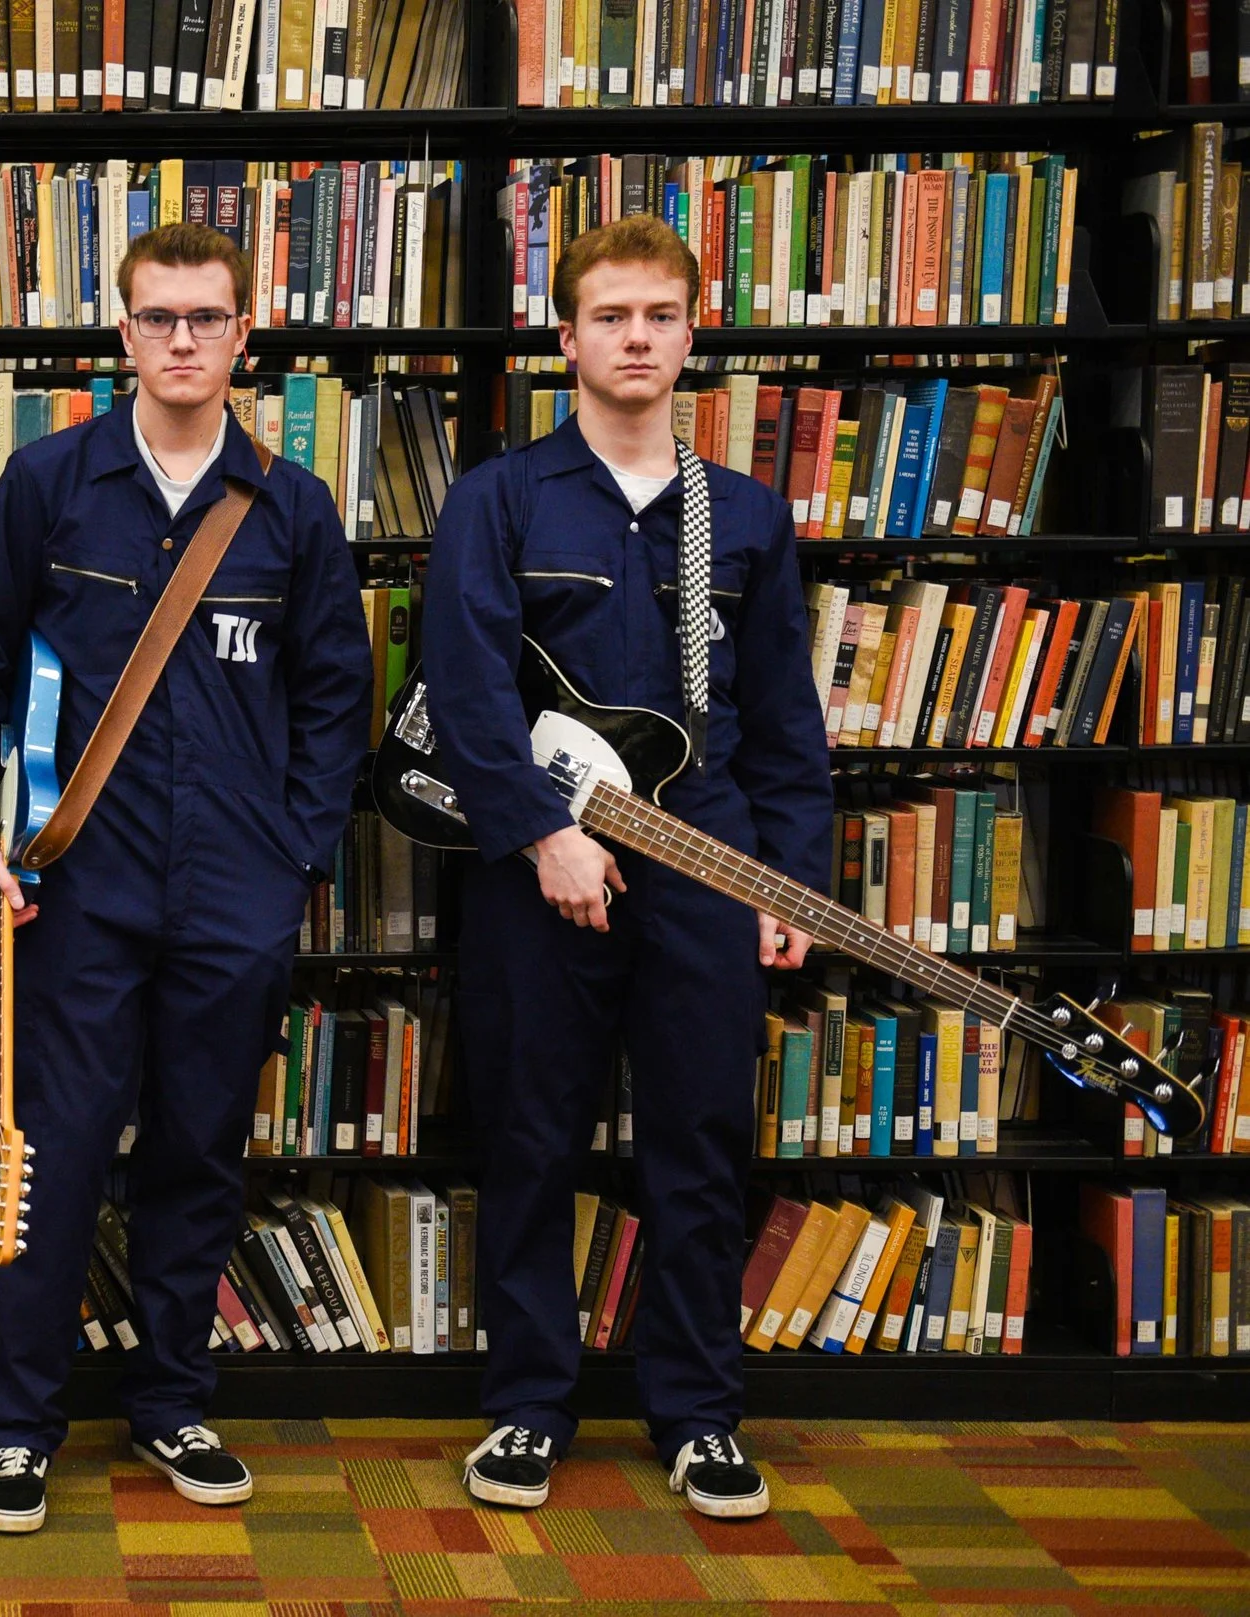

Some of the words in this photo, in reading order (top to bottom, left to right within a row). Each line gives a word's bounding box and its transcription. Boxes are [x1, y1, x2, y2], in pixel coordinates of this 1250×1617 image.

[265, 49, 274, 75] COMPA
[327, 176, 336, 191] The
[324, 192, 334, 221] poems
[516, 192, 526, 210] KOCH
[729, 184, 737, 216] WAITING
[927, 198, 939, 213] THE
[516, 214, 525, 226] THE
[1201, 177, 1215, 251] Thousands
[262, 228, 270, 242] THE
[325, 223, 333, 233] of
[516, 227, 525, 240] ART
[905, 222, 914, 258] Nightmare
[262, 243, 270, 259] FALL
[323, 239, 333, 265] Laura
[516, 241, 525, 250] OF
[262, 261, 269, 270] OF
[515, 251, 525, 276] POETRY
[830, 398, 839, 416] THE
[827, 418, 837, 449] WORLD
[980, 593, 996, 630] CERTAIN
[972, 633, 986, 665] WOMEN
[940, 658, 960, 714] SEARCHERS
[1079, 1059, 1117, 1087] Fender
[297, 1230, 316, 1262] JACK
[420, 1226, 429, 1257] KEROUAC
[420, 1259, 429, 1268] ON
[420, 1269, 429, 1295] RECORD
